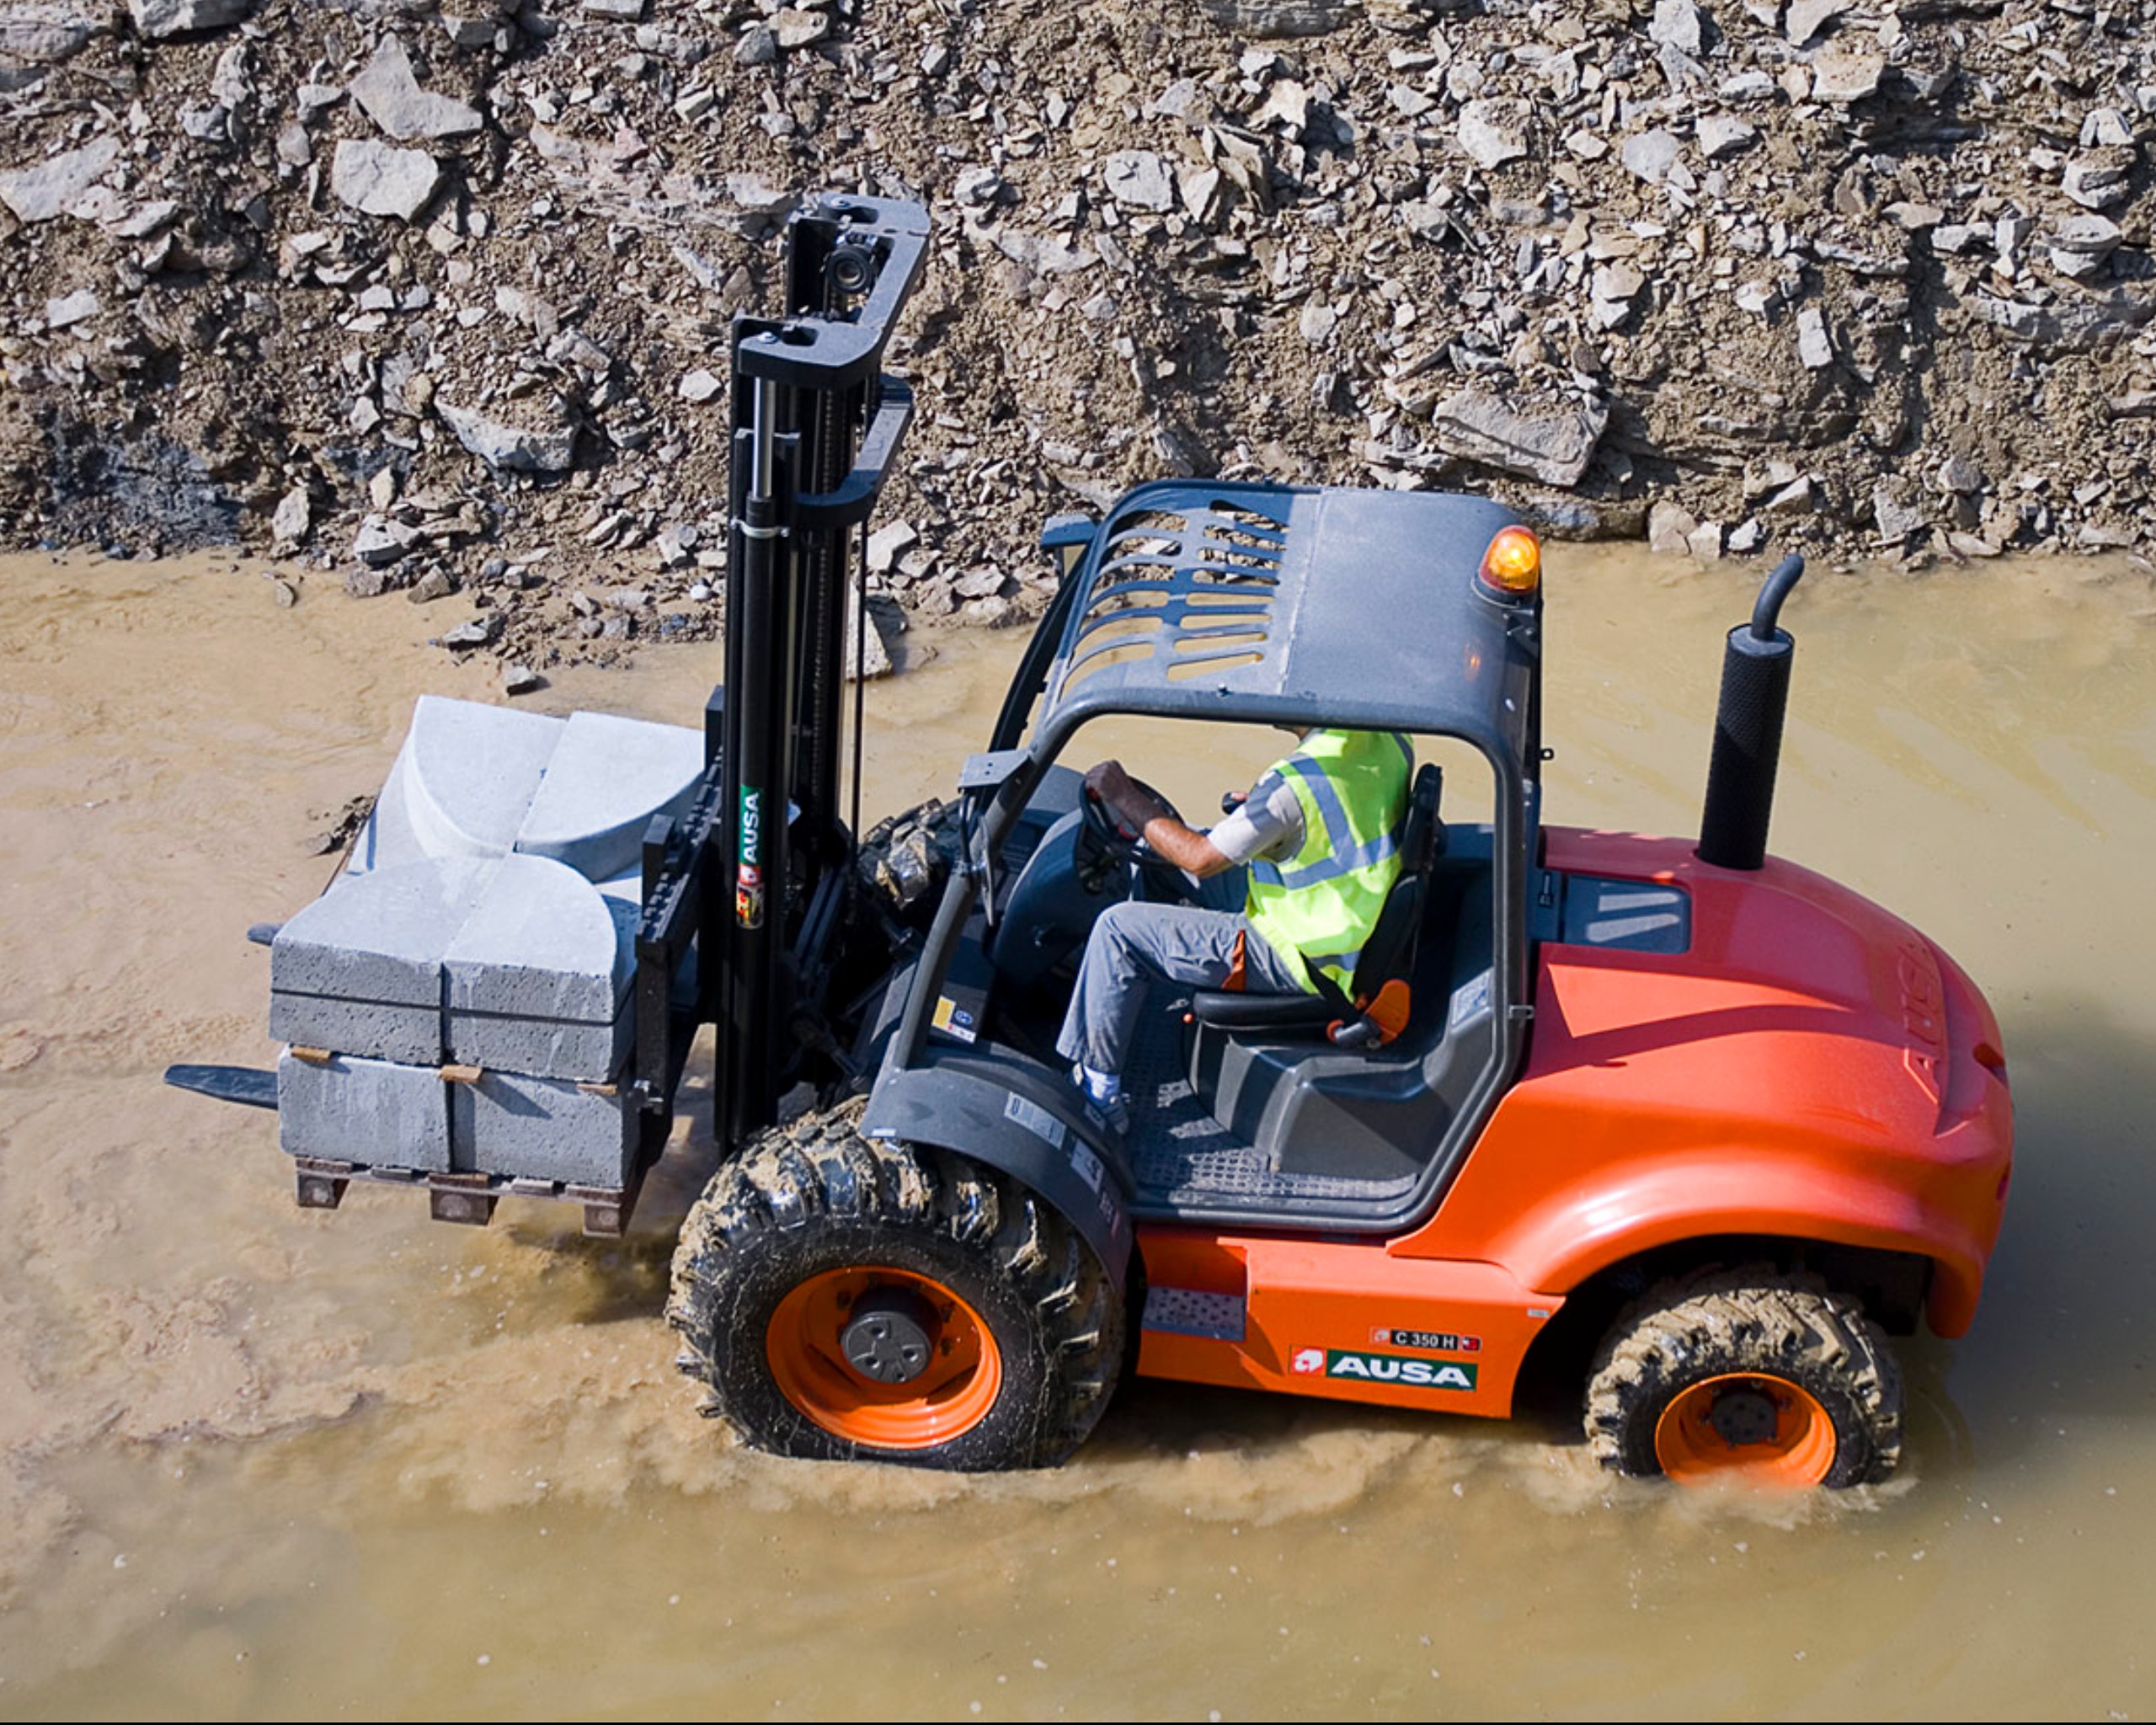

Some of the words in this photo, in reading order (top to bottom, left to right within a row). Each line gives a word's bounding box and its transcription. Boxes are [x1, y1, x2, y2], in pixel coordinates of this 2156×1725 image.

[744, 793, 759, 862] AUSA
[1396, 1332, 1407, 1344] C
[1412, 1332, 1438, 1347] 350
[1443, 1336, 1454, 1348] H
[1331, 1356, 1471, 1386] AUSA
